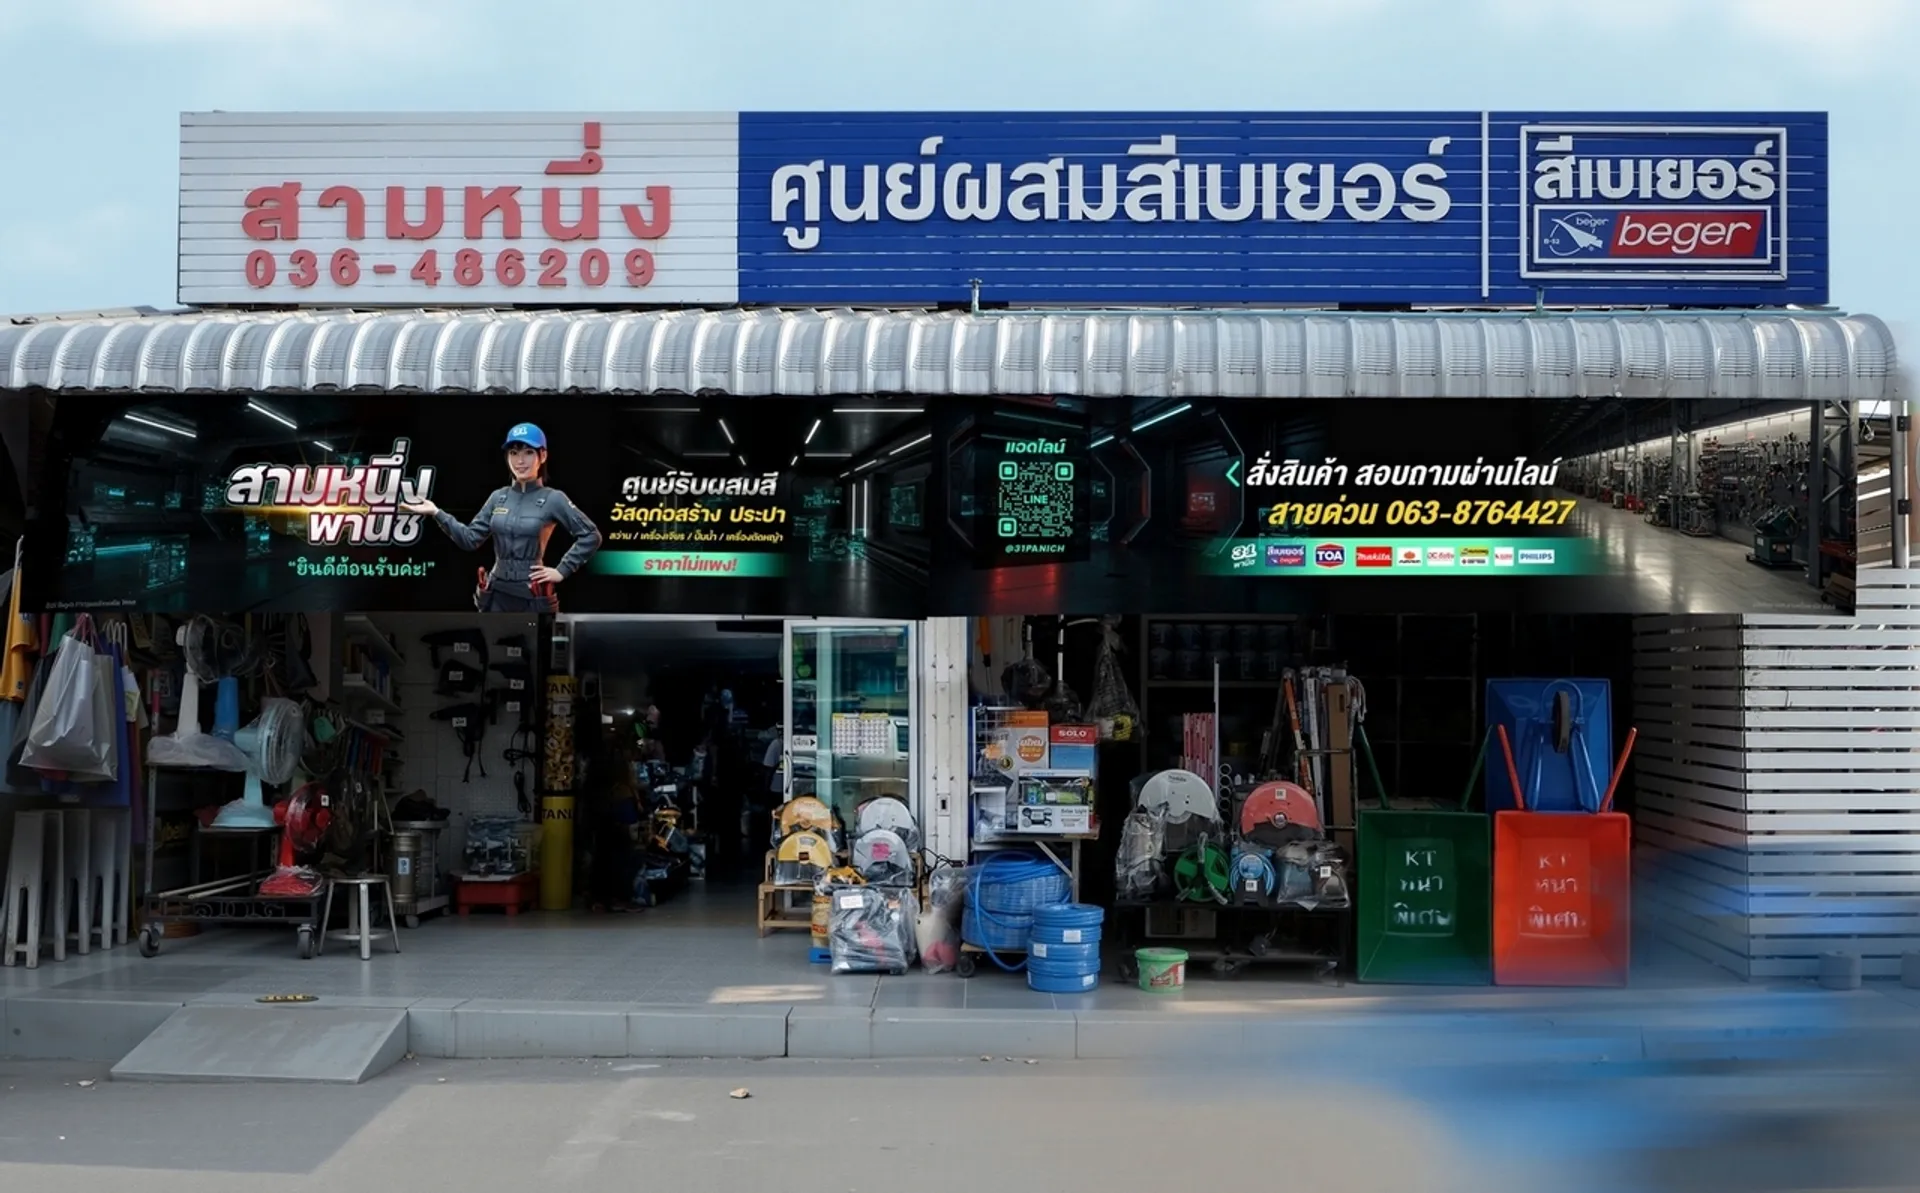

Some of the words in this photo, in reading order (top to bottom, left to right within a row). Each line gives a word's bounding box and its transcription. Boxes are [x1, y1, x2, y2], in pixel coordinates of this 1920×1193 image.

[242, 122, 671, 241] สามหนึ่ง
[1534, 135, 1775, 200] สีเบเยอร์
[769, 134, 1451, 249] ศูนย์ผสมสีเบเยอร์
[1618, 215, 1752, 255] beger
[244, 248, 656, 288] 036-486209
[1005, 438, 1067, 454] แอดไลน์
[227, 439, 436, 506] สามหนึ่ง
[1246, 451, 1348, 486] สั่งสินค้า
[1354, 457, 1562, 486] สอบถามผ่านไลน์
[621, 470, 780, 502] ศูนย์รับผสมสี
[1023, 494, 1049, 505] LINE
[308, 506, 422, 546] พานิช
[610, 502, 721, 527] วัสดุก่อสร้าง
[729, 505, 786, 523] ประปา
[1268, 495, 1378, 525] สายด่วน
[1385, 500, 1576, 526] 063-8764427
[644, 555, 738, 572] ราคาไม่แพง!
[1005, 544, 1066, 554] @31PANICH
[1317, 550, 1343, 561] TOA
[1520, 552, 1553, 560] PHILIPS
[1058, 729, 1087, 738] SOLO
[1405, 850, 1437, 867] KT
